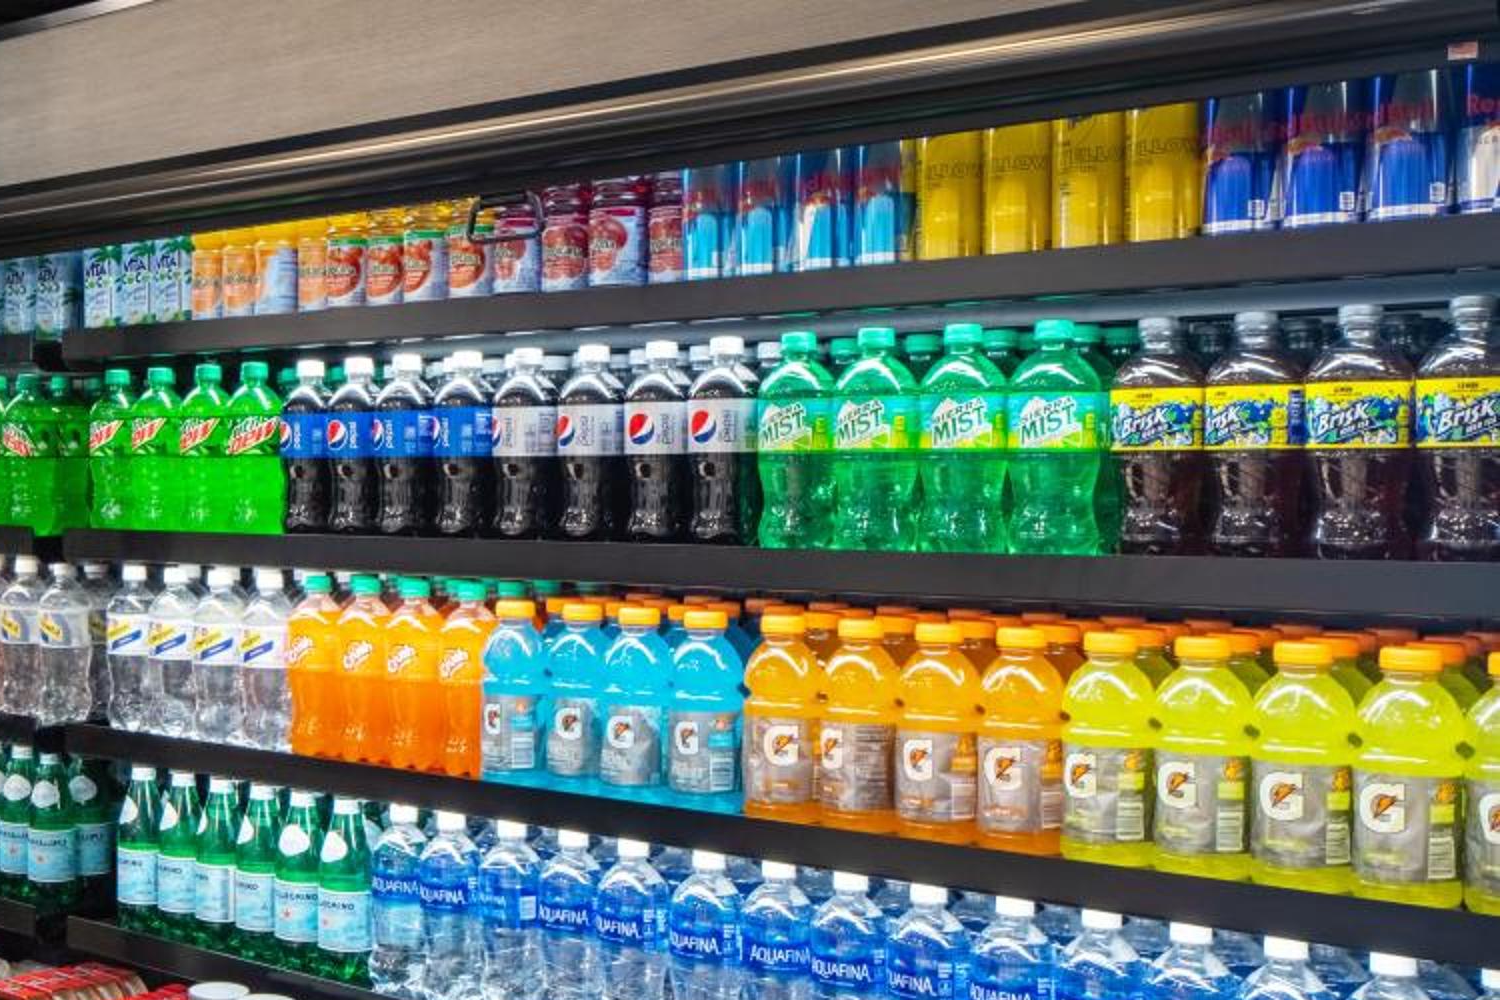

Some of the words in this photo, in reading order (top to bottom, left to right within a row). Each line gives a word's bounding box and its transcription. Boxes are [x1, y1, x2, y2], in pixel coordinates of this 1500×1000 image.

[933, 405, 984, 444] MIST
[1022, 404, 1075, 444] MIST
[764, 725, 799, 766] G
[903, 740, 933, 782] G
[985, 747, 1022, 790] G
[1064, 753, 1096, 798] G
[1158, 762, 1196, 808] G
[1260, 772, 1303, 821] G
[1360, 783, 1405, 833] G
